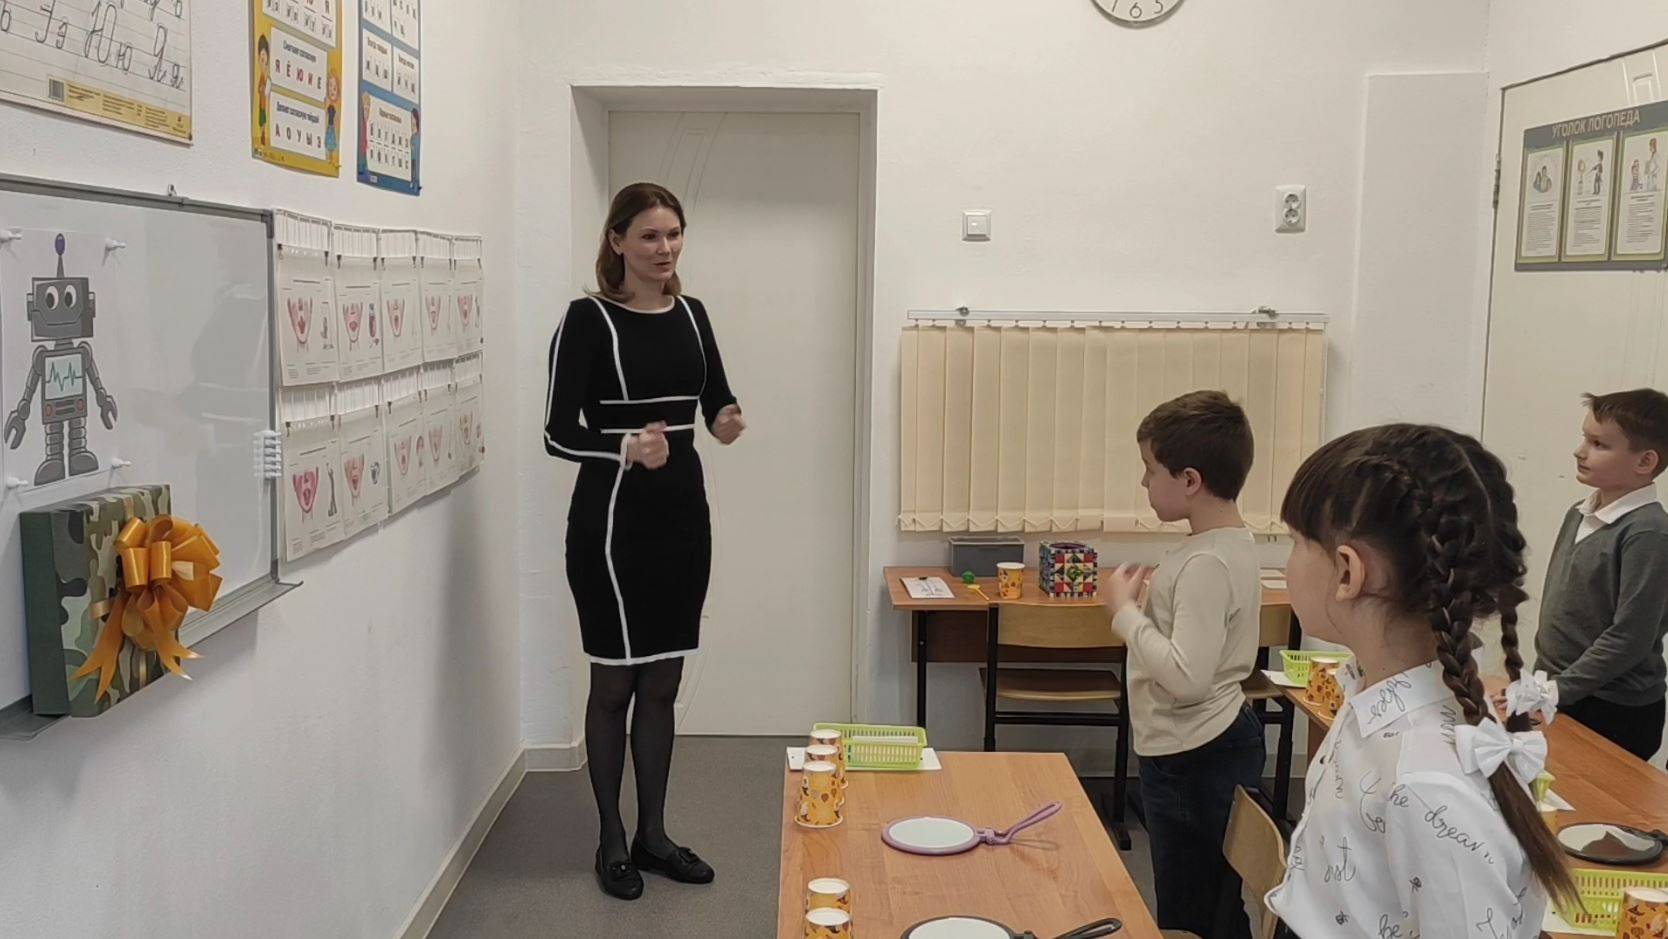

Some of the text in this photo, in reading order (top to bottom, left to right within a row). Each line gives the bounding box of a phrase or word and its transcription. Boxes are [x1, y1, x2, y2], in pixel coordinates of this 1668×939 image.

[1129, 2, 1143, 19] 6
[275, 59, 281, 74] Я
[297, 67, 304, 82] Ю
[275, 123, 281, 138] А
[296, 129, 302, 142] У
[1552, 109, 1641, 138] УГОЛОК ЛОГОПЕДА
